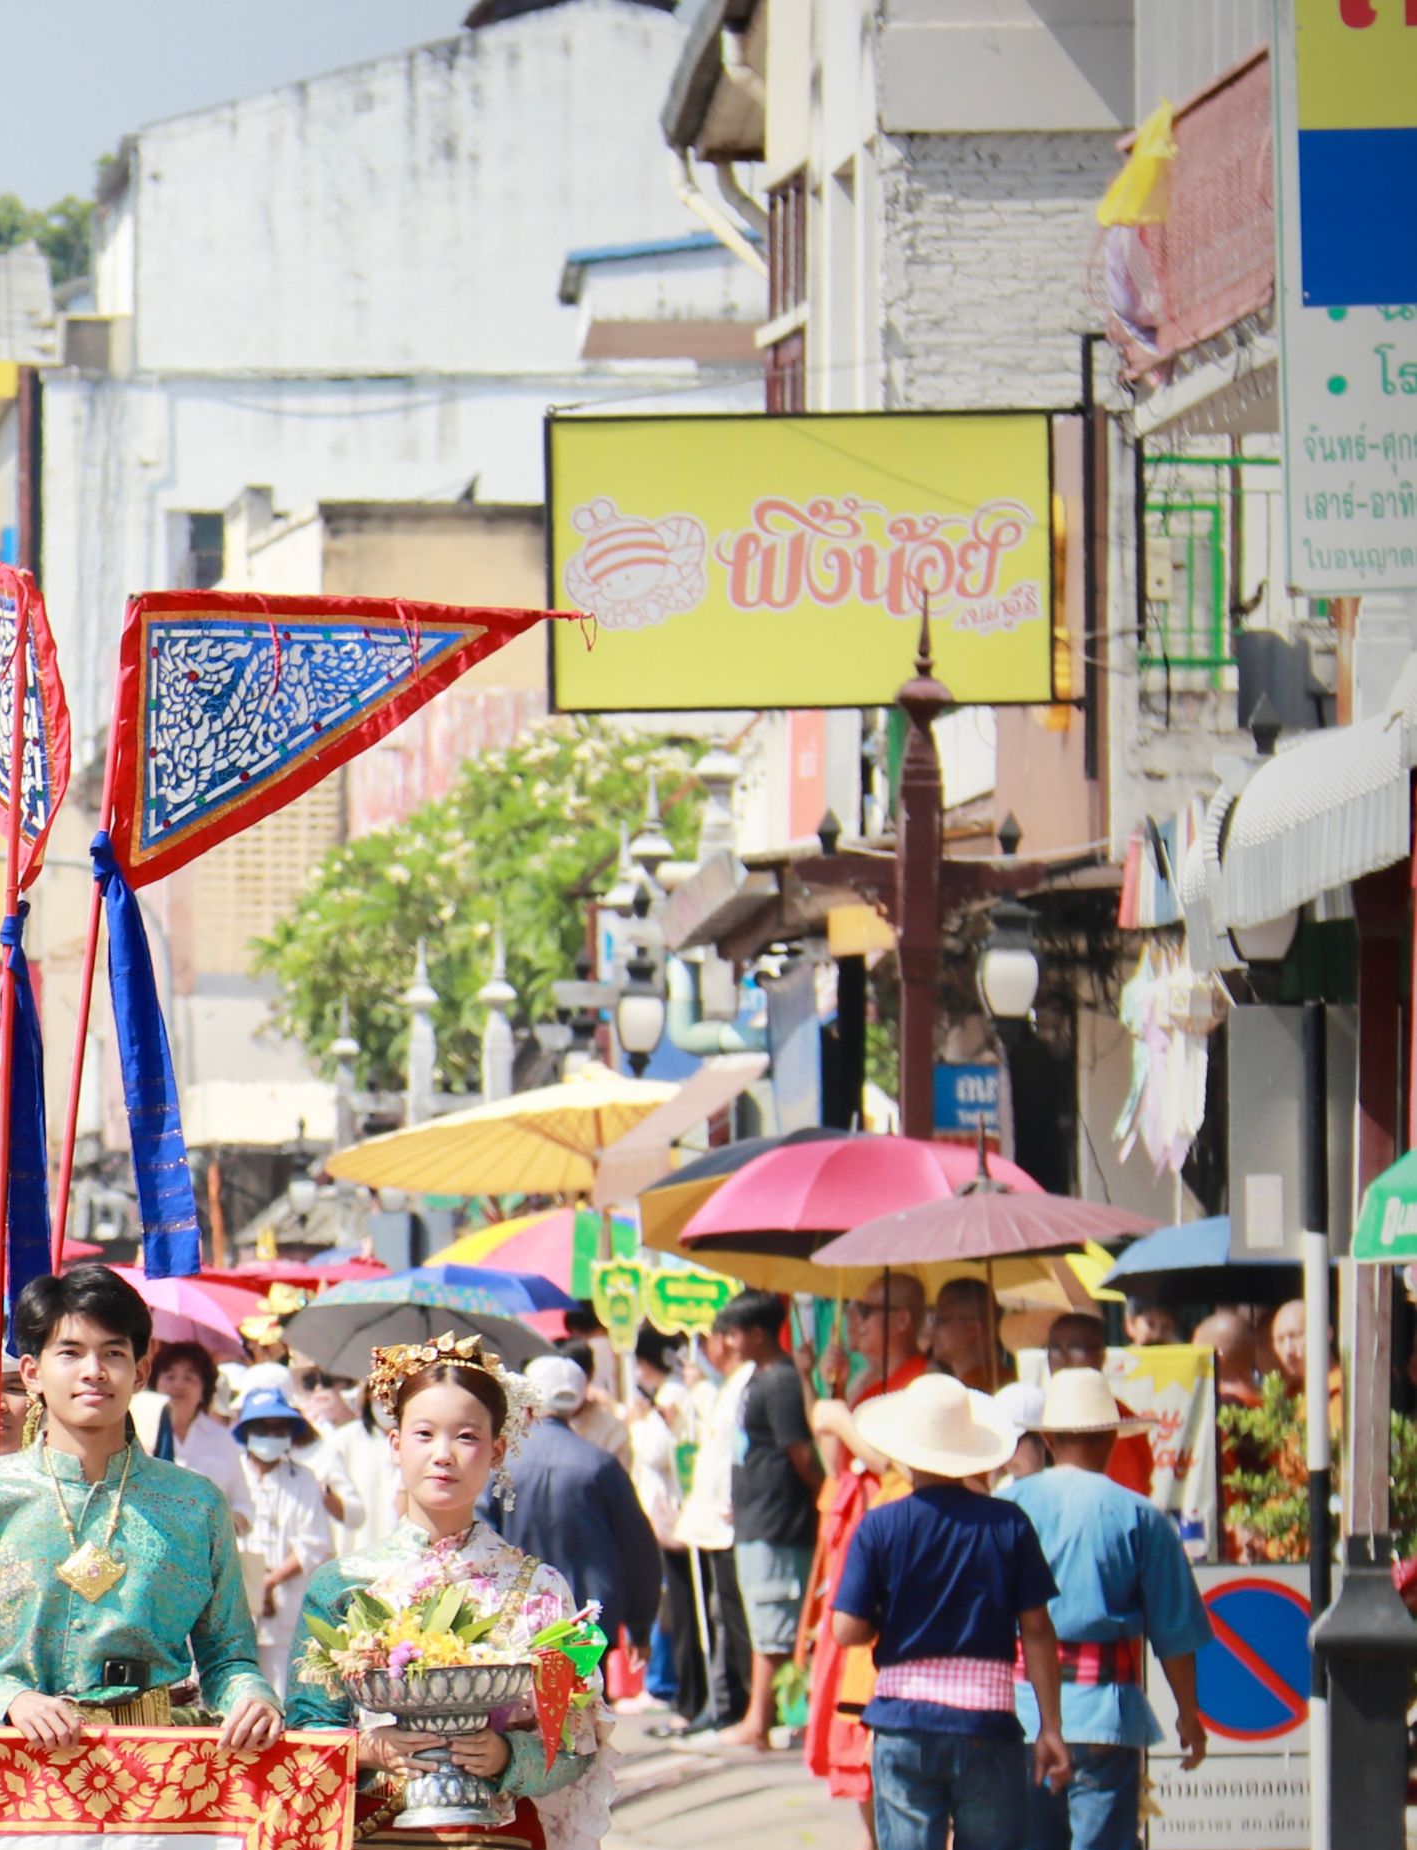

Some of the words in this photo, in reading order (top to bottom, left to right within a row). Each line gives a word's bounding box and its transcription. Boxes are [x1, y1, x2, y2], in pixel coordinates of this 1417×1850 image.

[1303, 423, 1417, 476] จันทร์-ศุก
[1304, 480, 1417, 521] เสาร์-อาทิ
